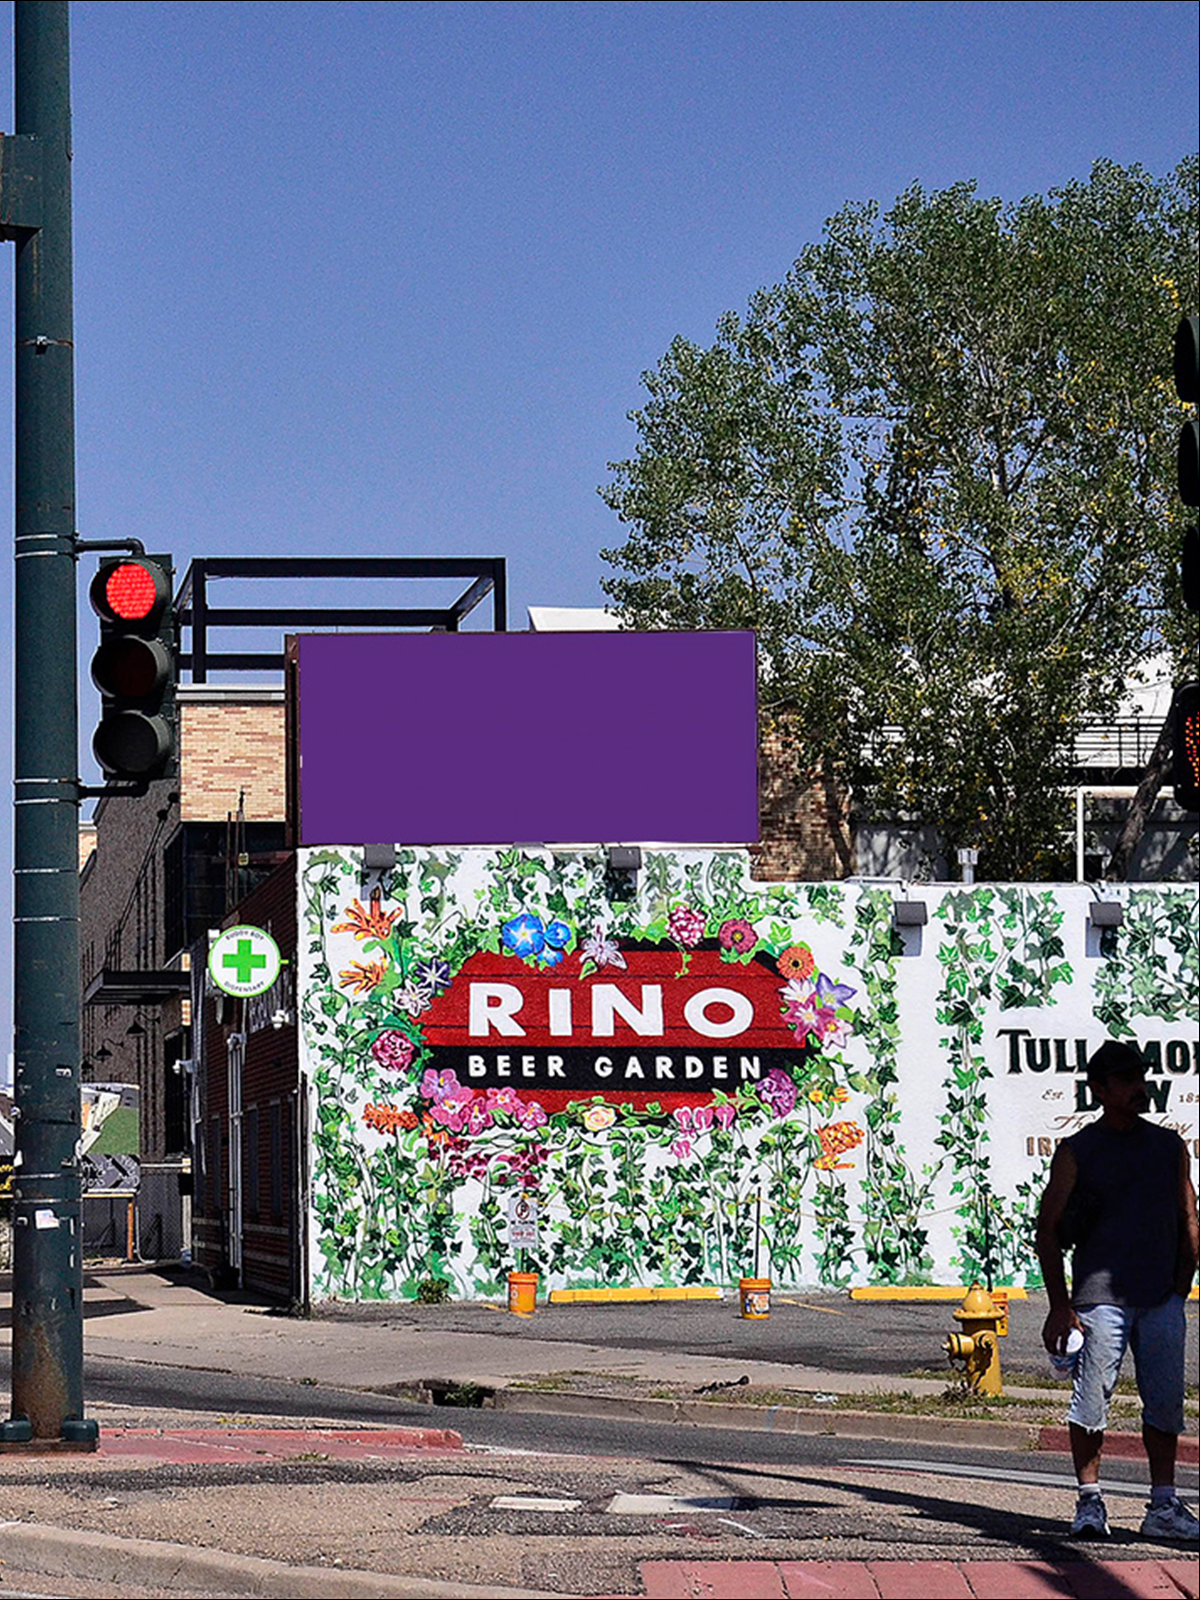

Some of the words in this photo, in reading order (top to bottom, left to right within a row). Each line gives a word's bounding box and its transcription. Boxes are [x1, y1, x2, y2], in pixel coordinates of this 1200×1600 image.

[224, 981, 264, 992] DISPENSARY
[468, 982, 754, 1038] RINO
[468, 1055, 566, 1078] BEER
[594, 1055, 761, 1080] GARDEN
[995, 1028, 1200, 1074] TULLMO
